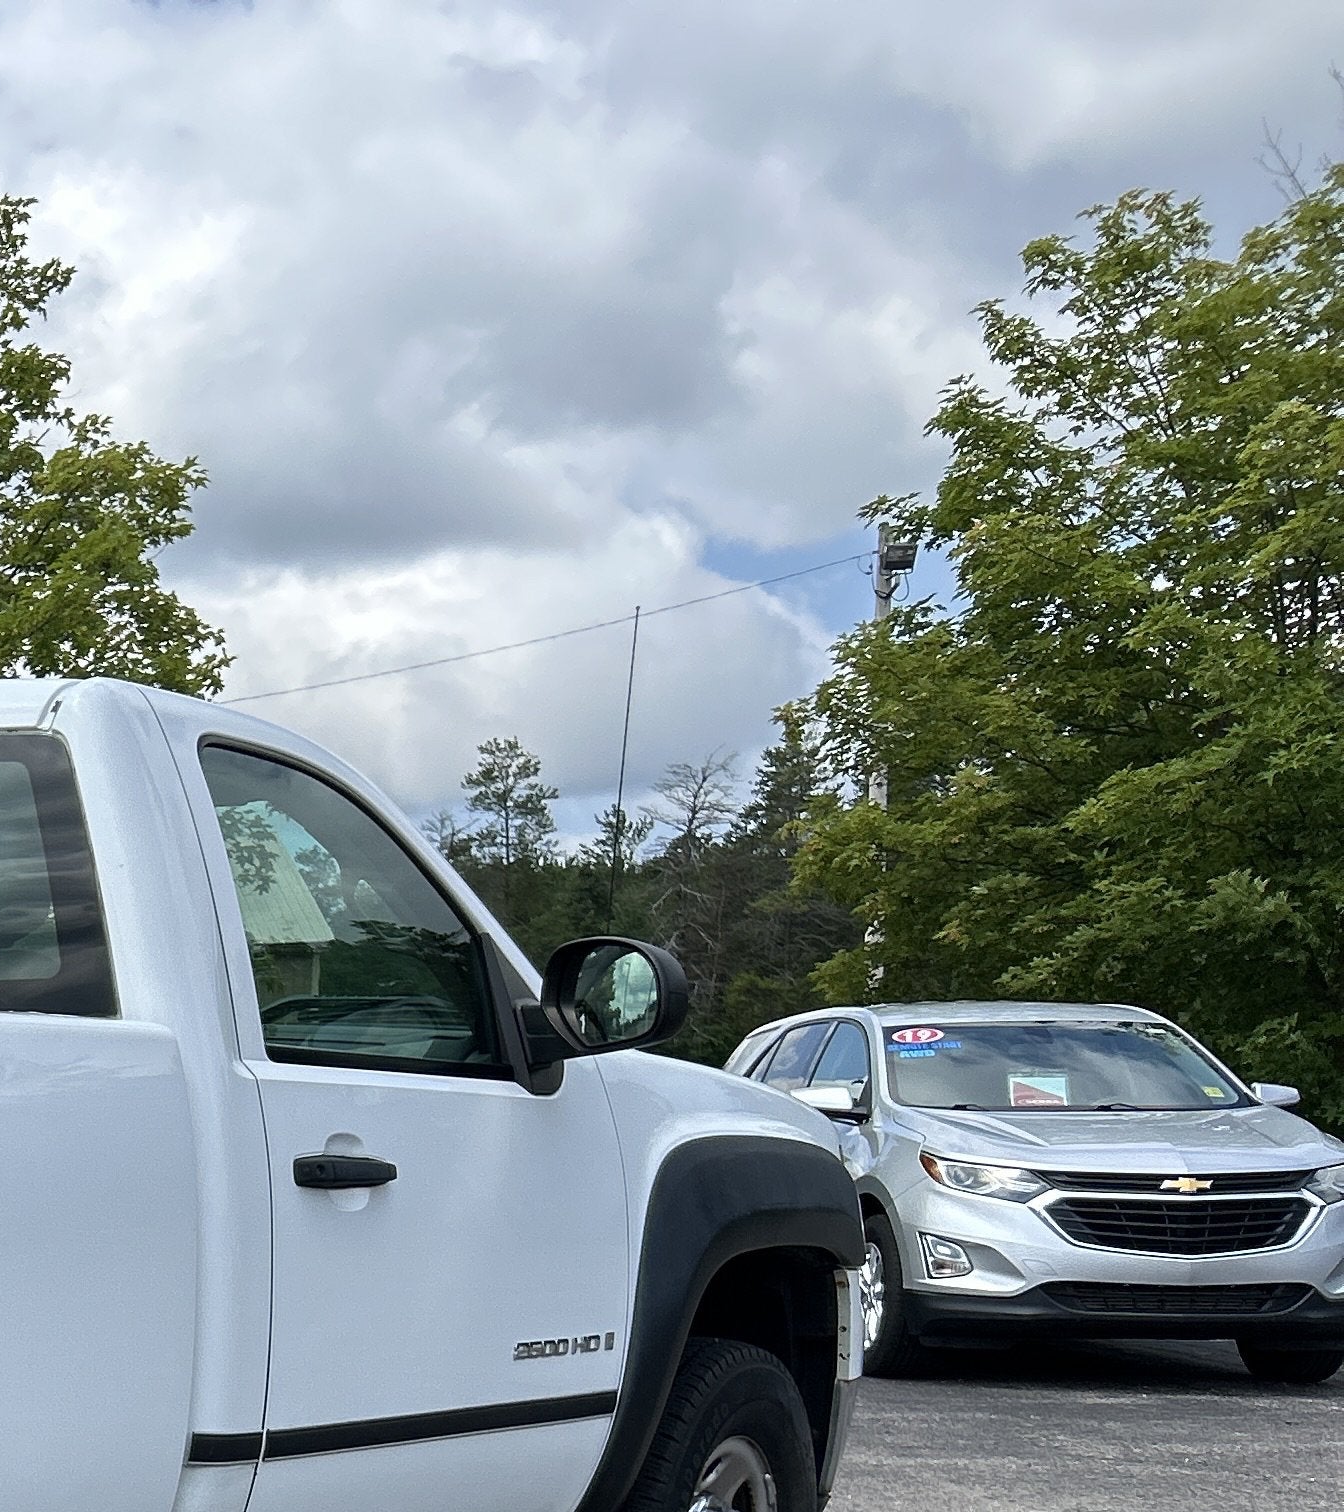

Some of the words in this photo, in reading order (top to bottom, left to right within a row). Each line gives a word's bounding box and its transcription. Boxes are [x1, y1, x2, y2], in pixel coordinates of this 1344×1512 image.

[887, 1043, 929, 1051] REMOTE
[930, 1041, 962, 1049] START
[899, 1050, 935, 1058] AWD
[513, 1339, 569, 1361] 2500
[571, 1334, 601, 1355] HD
